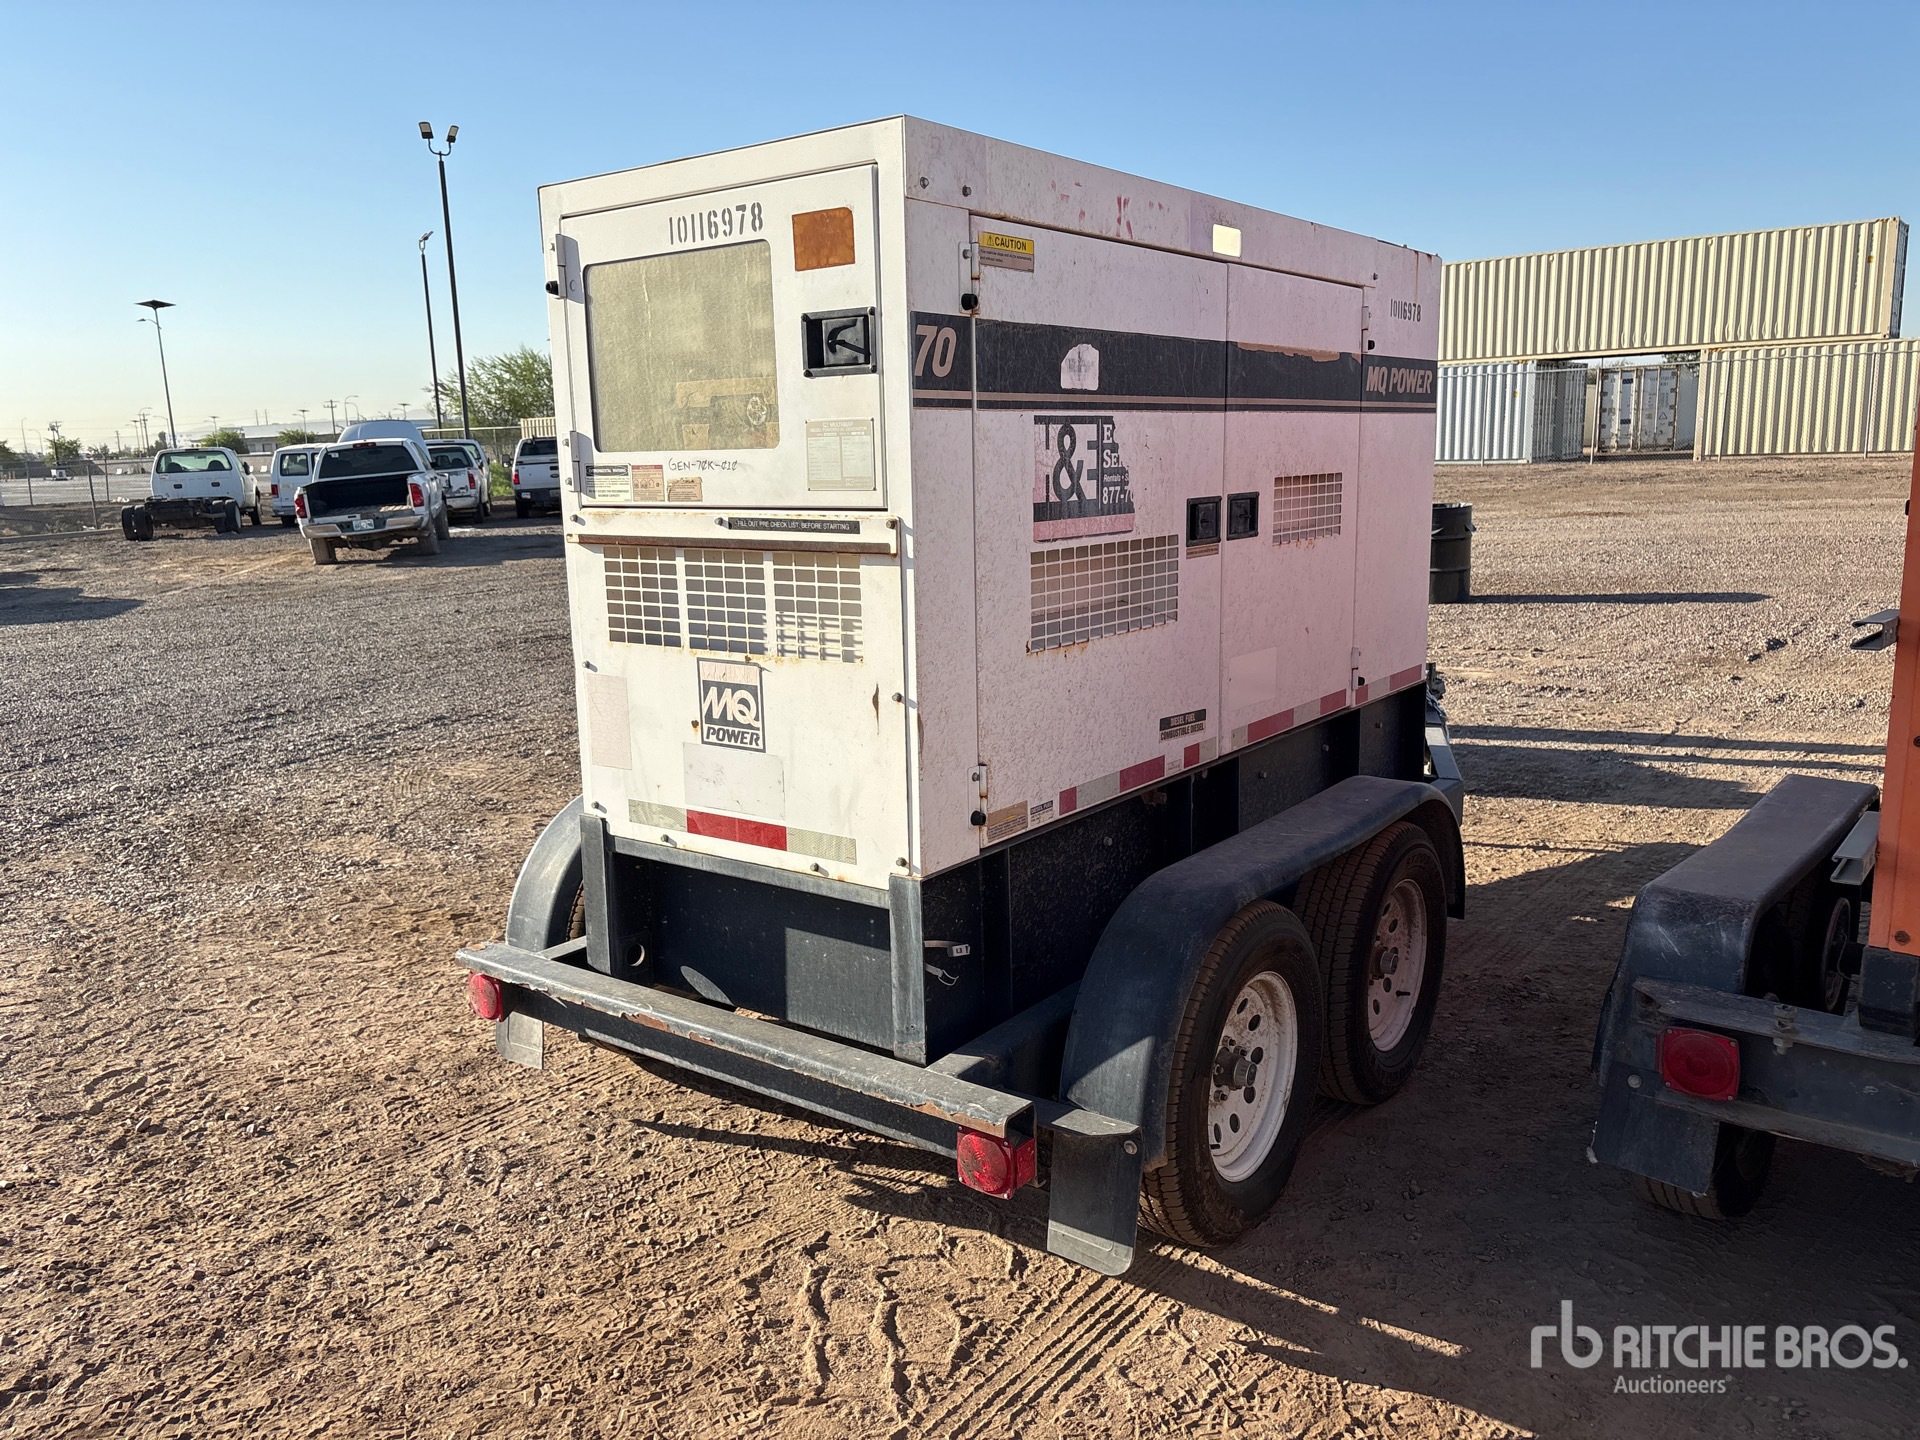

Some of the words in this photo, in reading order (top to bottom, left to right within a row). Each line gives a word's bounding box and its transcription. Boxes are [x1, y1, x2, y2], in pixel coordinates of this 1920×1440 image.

[669, 202, 763, 245] 10116978
[994, 236, 1027, 251] CAUTION
[1390, 298, 1422, 323] 10116978
[914, 324, 957, 378] 70
[1366, 365, 1388, 396] MQ
[1389, 367, 1433, 394] POWER
[770, 521, 788, 529] CHECK
[801, 522, 822, 530] BEFORE
[822, 523, 850, 531] STARTING
[702, 686, 760, 728] MQ
[1160, 725, 1190, 741] COMBUSTIBLE
[1190, 722, 1205, 734] DIESEL
[1170, 715, 1184, 727] DIESEL
[1185, 713, 1196, 723] FUEL
[705, 726, 761, 747] POWER
